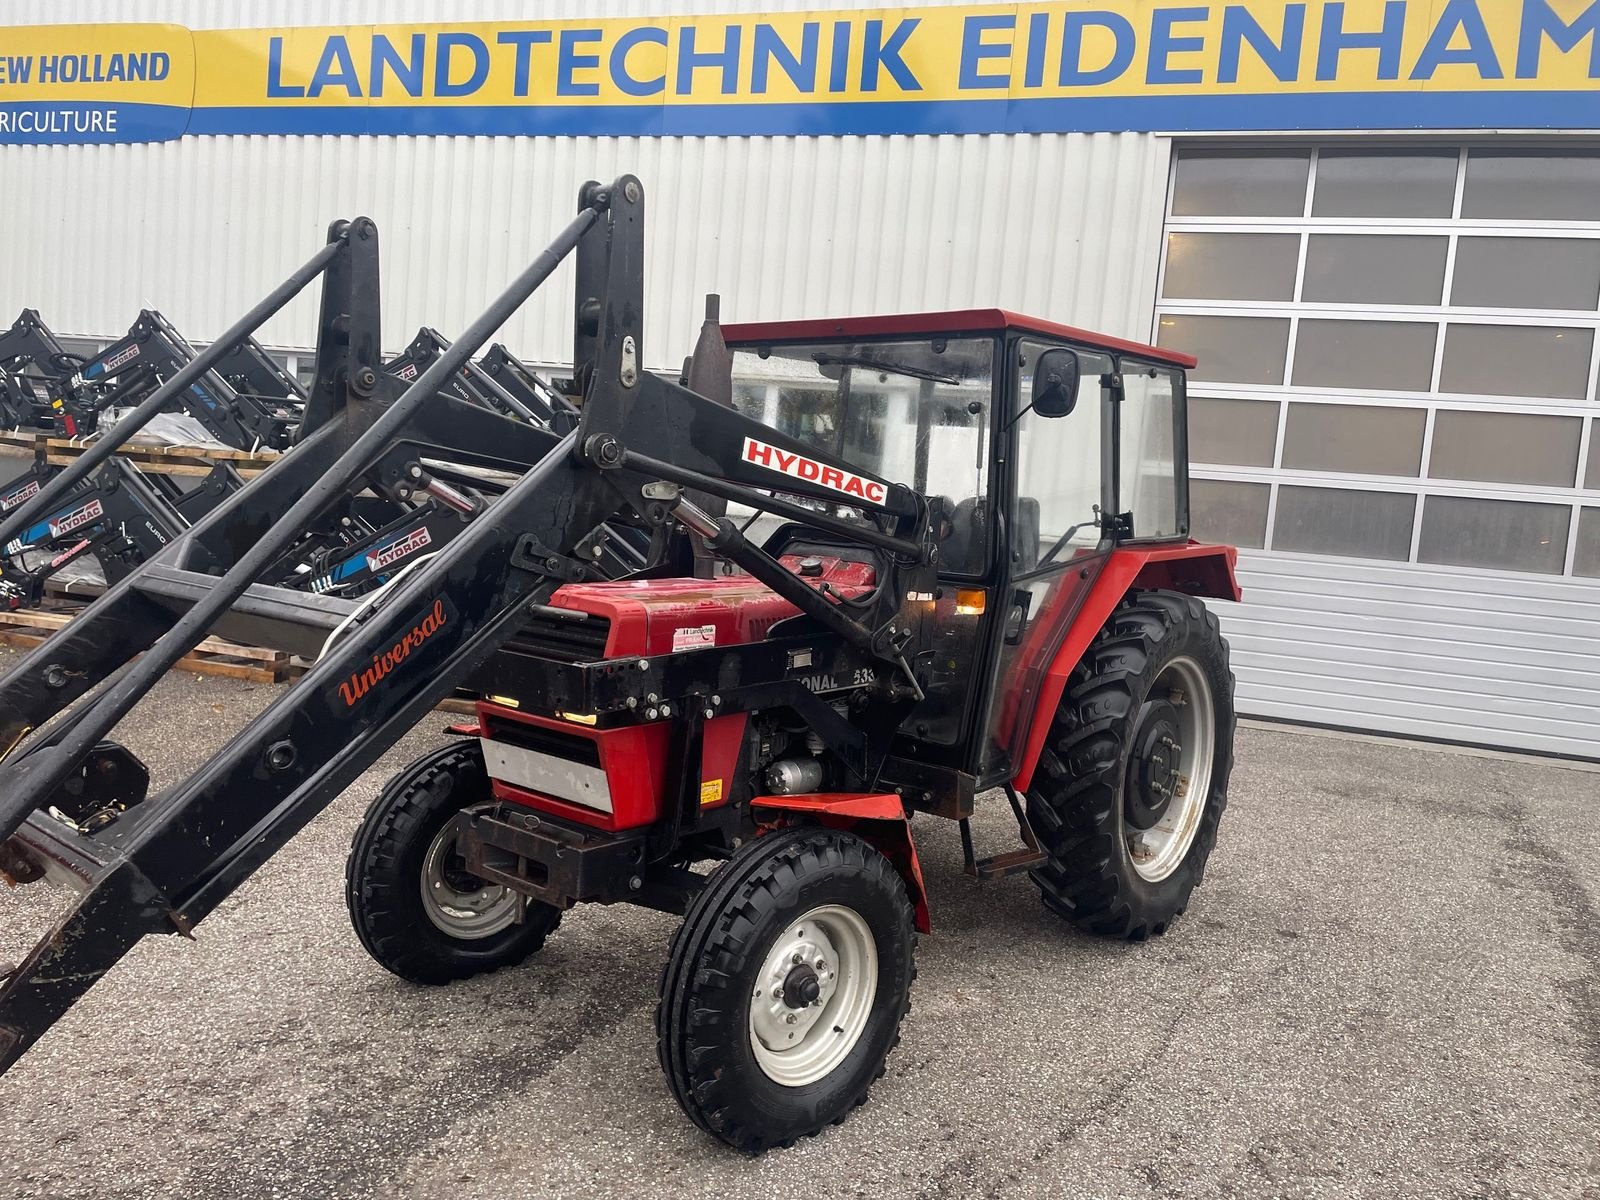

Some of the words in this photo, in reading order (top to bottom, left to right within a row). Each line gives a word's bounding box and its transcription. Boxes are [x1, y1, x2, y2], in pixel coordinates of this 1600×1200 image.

[267, 18, 924, 98] LANDTECHNIK
[958, 0, 1600, 90] EIDENHAM
[38, 52, 170, 83] HOLLAND
[108, 348, 139, 369] HYDRAC
[452, 382, 470, 400] EURO
[747, 440, 884, 502] HYDRAC
[7, 486, 38, 507] HYDRAC
[59, 506, 101, 533] HYDRAC
[144, 520, 167, 544] EURO
[378, 535, 428, 567] HYDRAC
[338, 599, 447, 706] Universal
